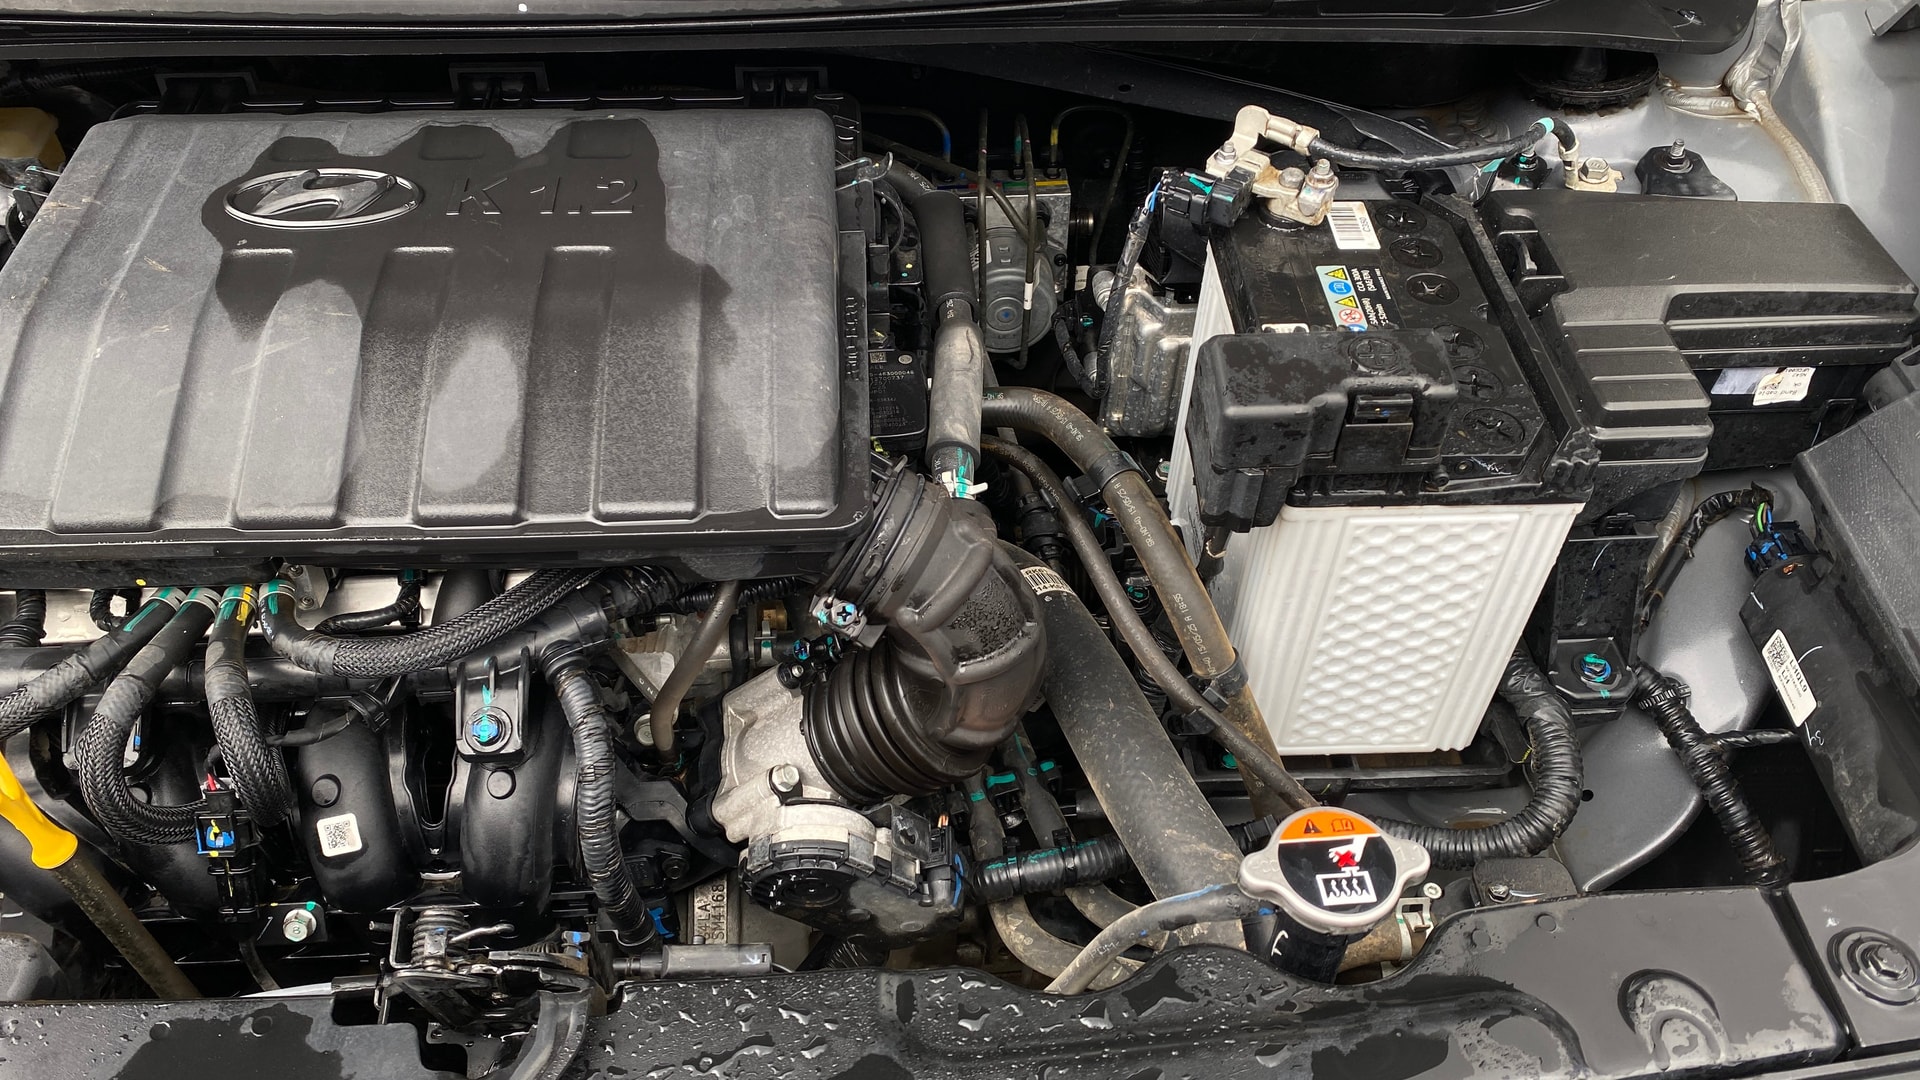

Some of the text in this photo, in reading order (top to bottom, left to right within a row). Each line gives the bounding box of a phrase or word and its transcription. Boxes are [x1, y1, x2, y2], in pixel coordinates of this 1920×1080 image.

[1357, 280, 1365, 291] CCA
[1361, 272, 1377, 290] (SAE/EN)
[1172, 593, 1189, 612] 18:55
[1188, 624, 1207, 653] 15/05/25
[1780, 669, 1792, 684] LH
[712, 884, 724, 940] SM4168
